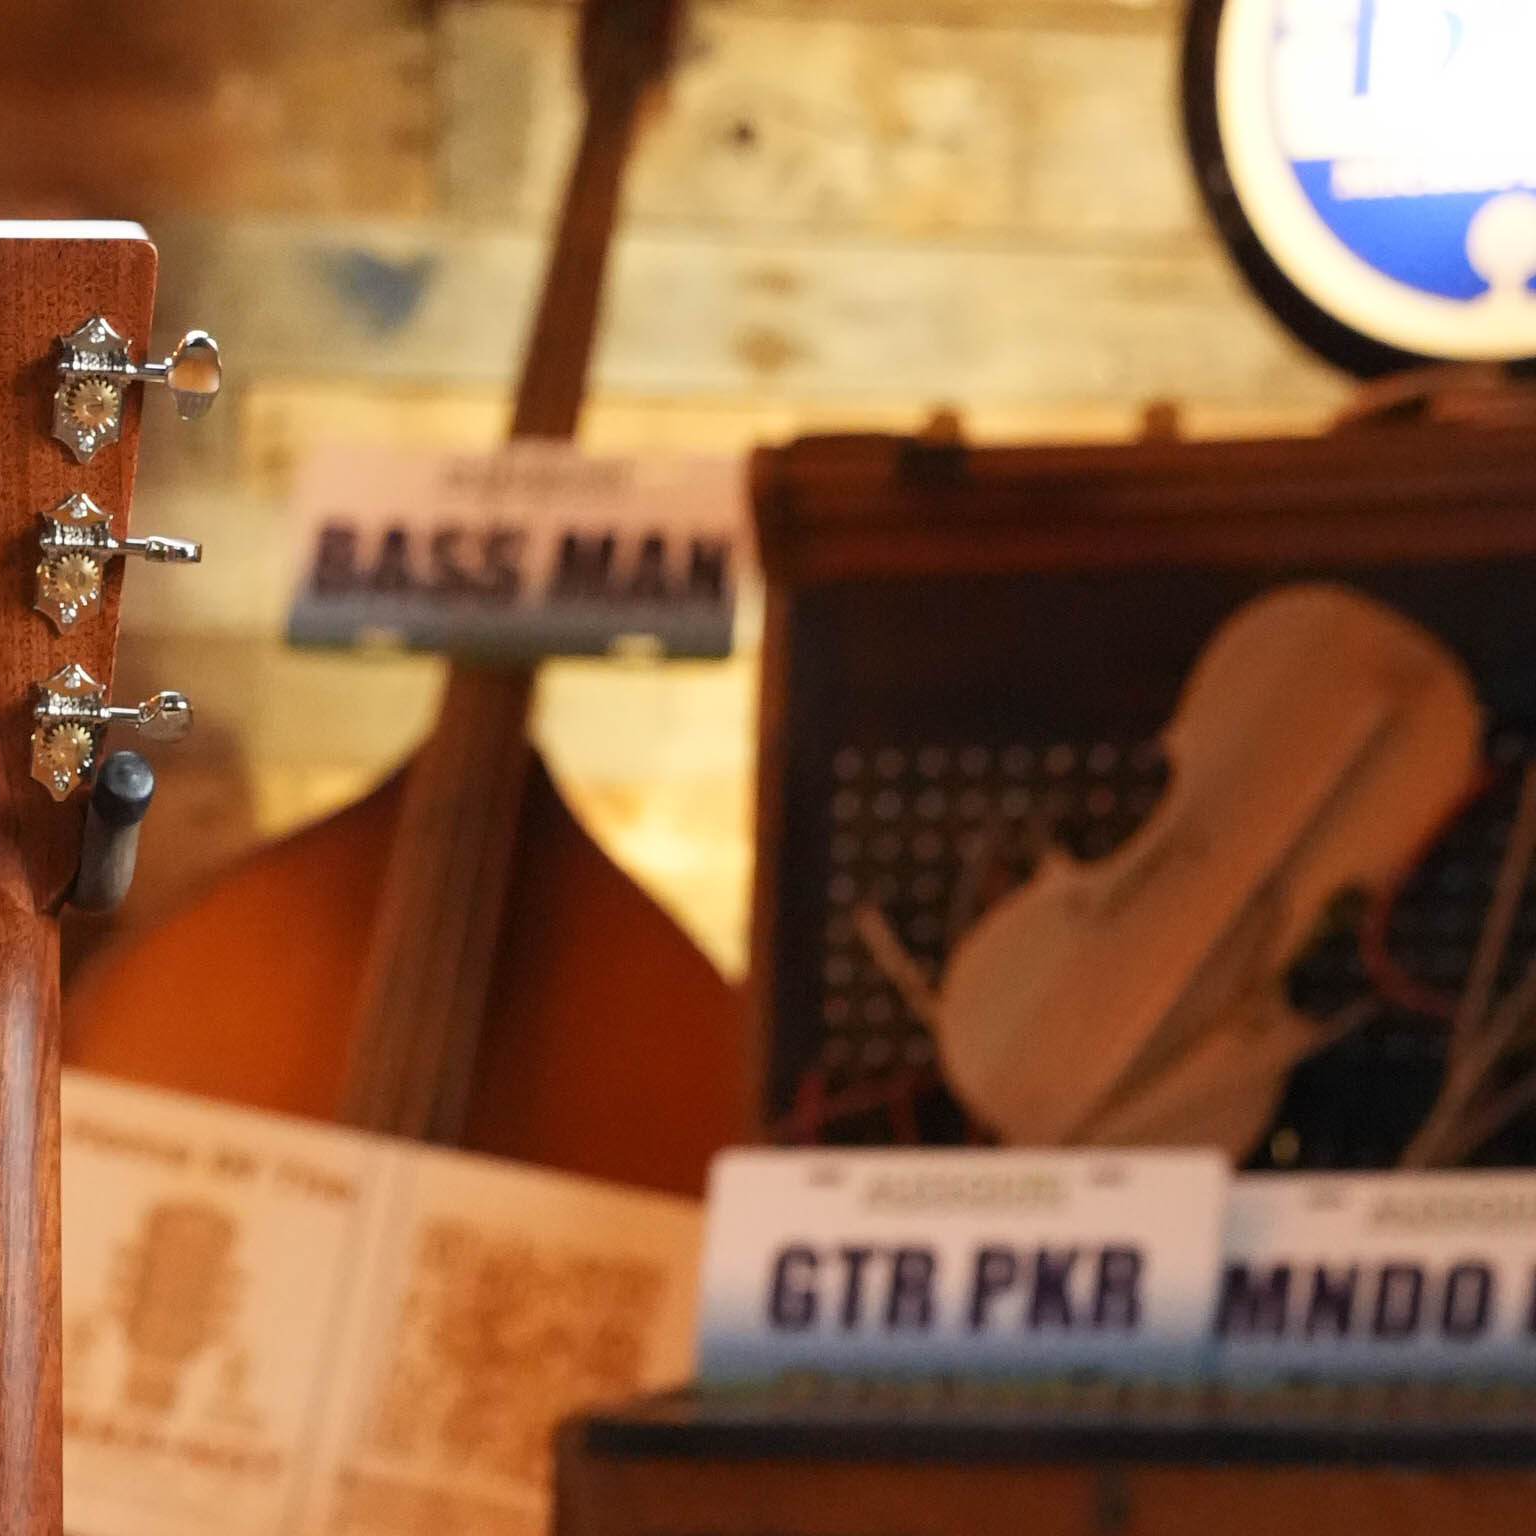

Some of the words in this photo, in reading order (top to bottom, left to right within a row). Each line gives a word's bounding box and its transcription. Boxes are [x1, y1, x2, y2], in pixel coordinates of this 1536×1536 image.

[311, 522, 524, 602] BASS
[552, 526, 731, 605] MAN
[768, 1244, 936, 1331] GTR
[968, 1244, 1144, 1332] PKR
[1215, 1262, 1492, 1339] MNDO
